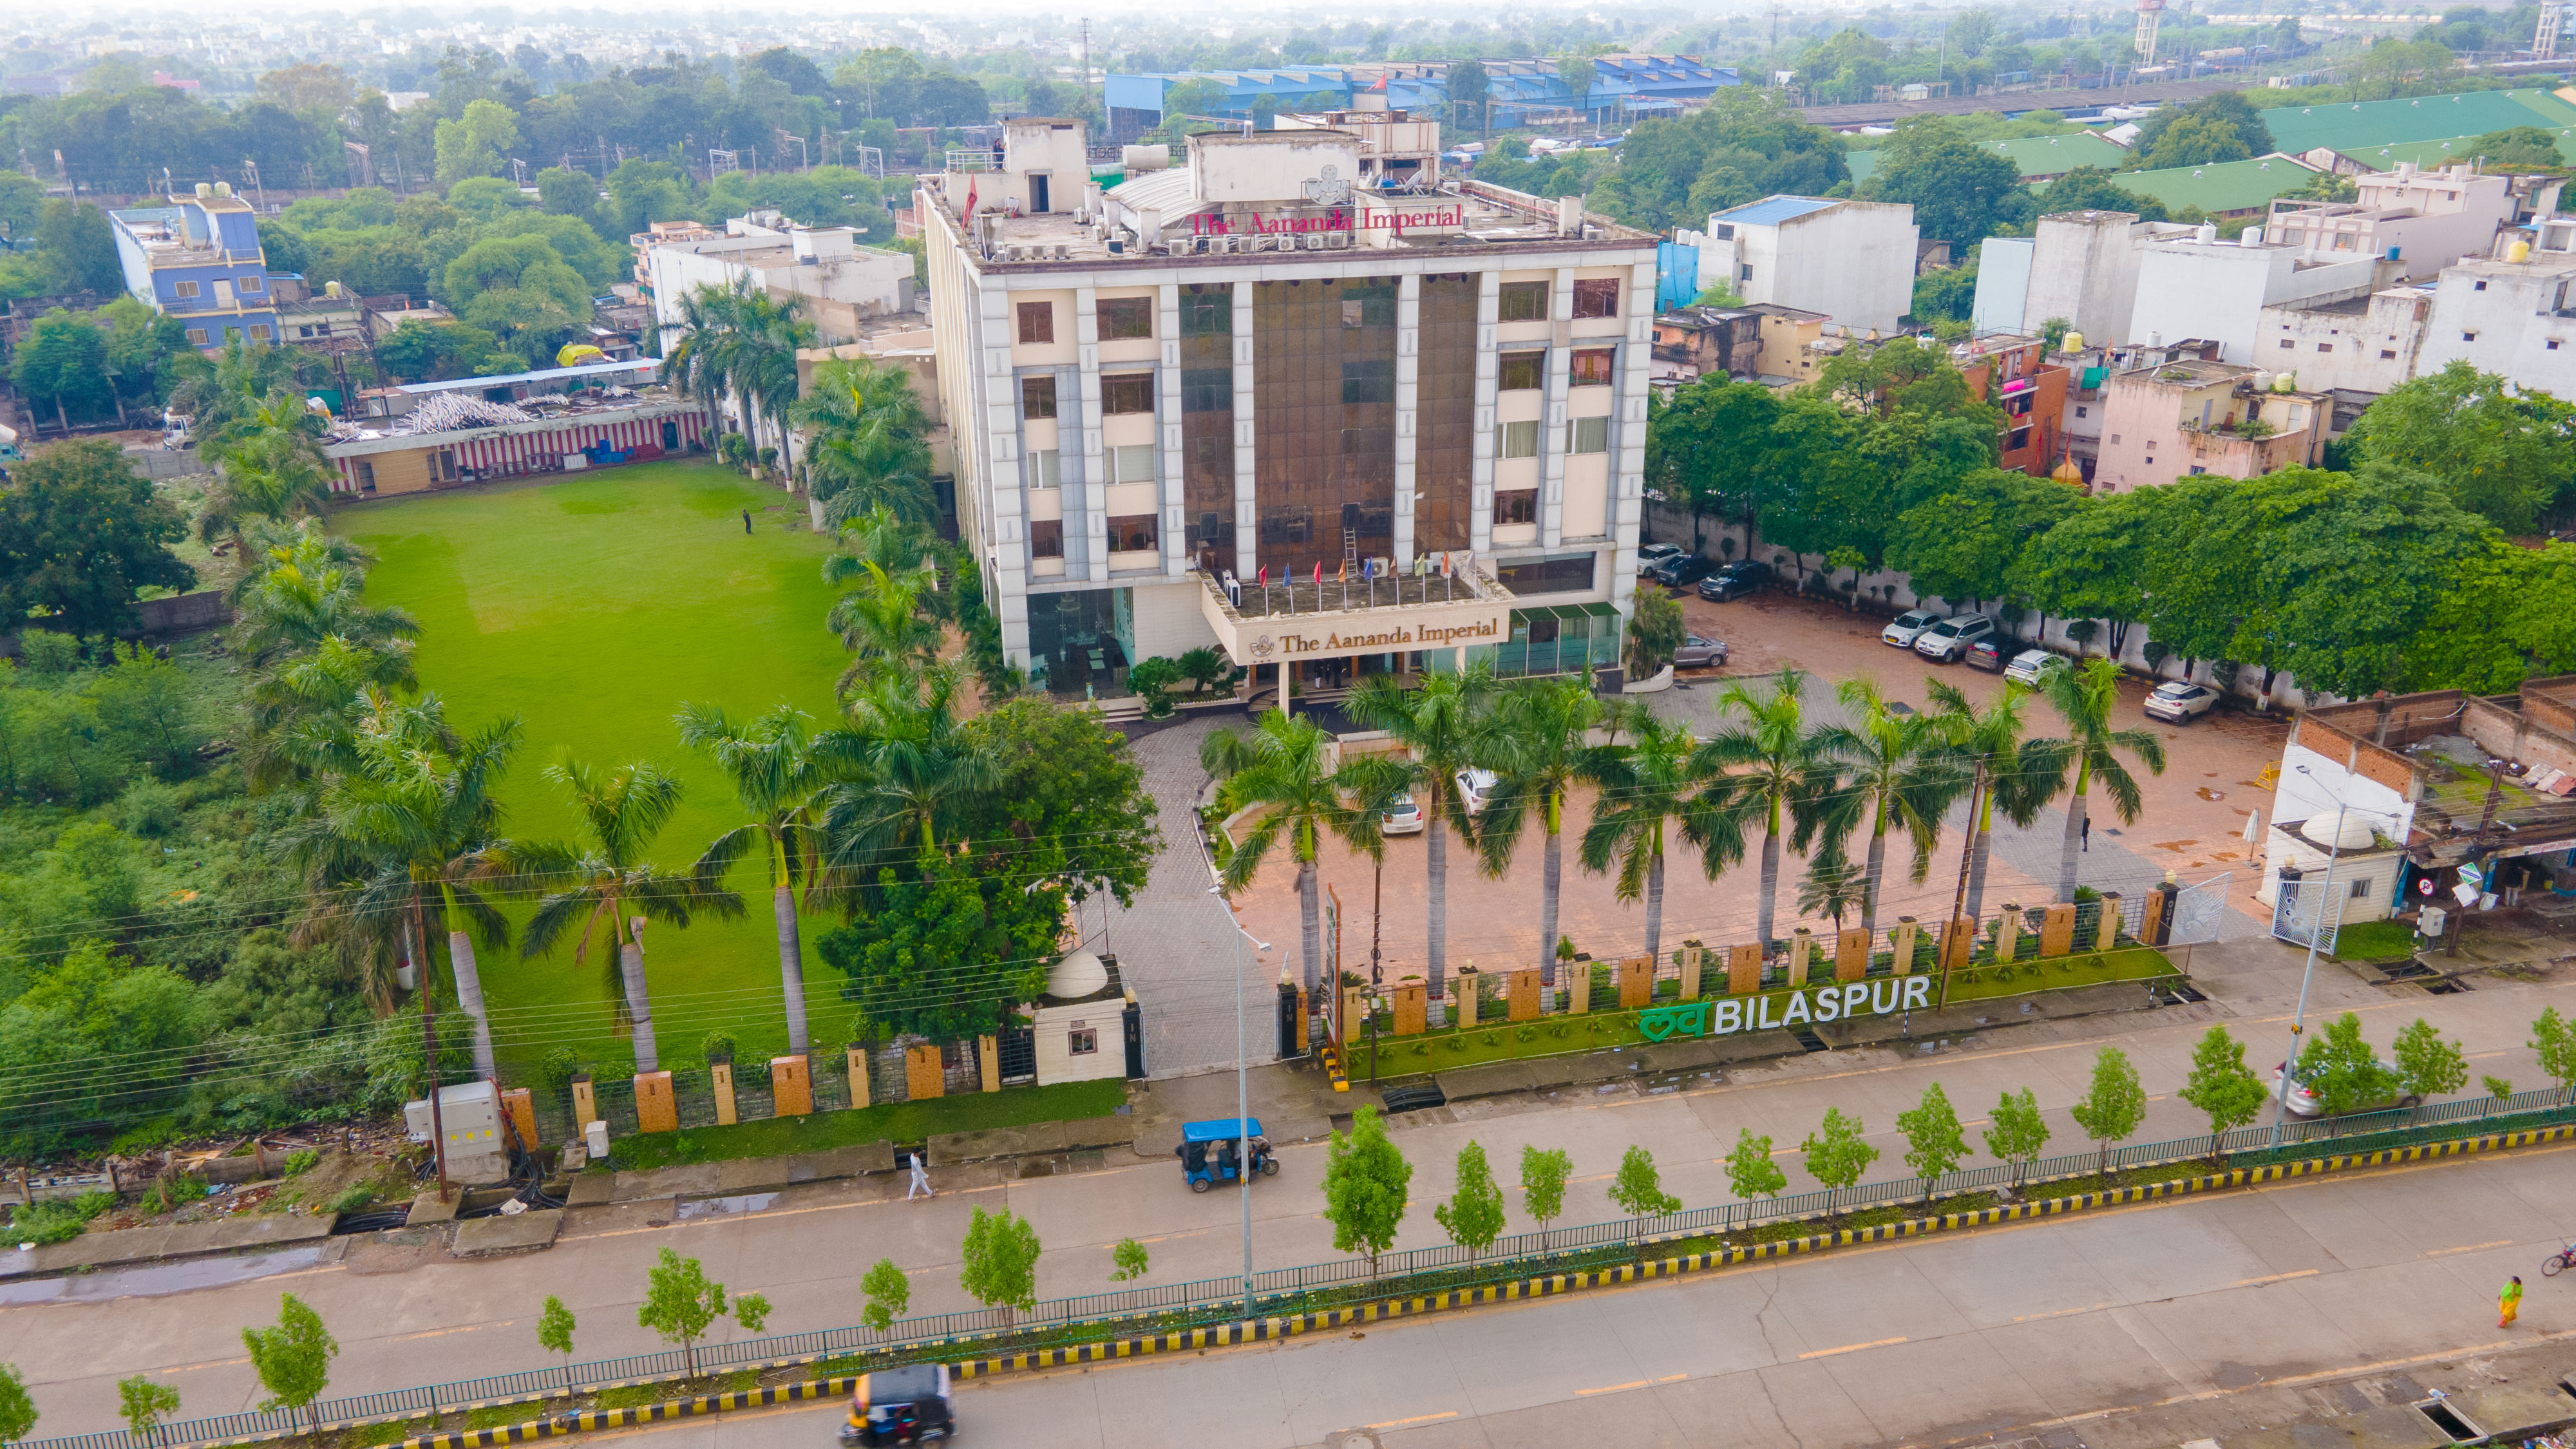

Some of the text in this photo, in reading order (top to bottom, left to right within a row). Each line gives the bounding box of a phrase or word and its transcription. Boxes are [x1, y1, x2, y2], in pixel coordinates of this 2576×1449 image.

[1186, 204, 1461, 236] The Aananda Imperial
[1280, 618, 1498, 653] The Aananda Imperial
[1286, 1004, 1293, 1022] IN
[1639, 976, 1931, 1043] लव BILASPUR
[1130, 1023, 1136, 1042] IN
